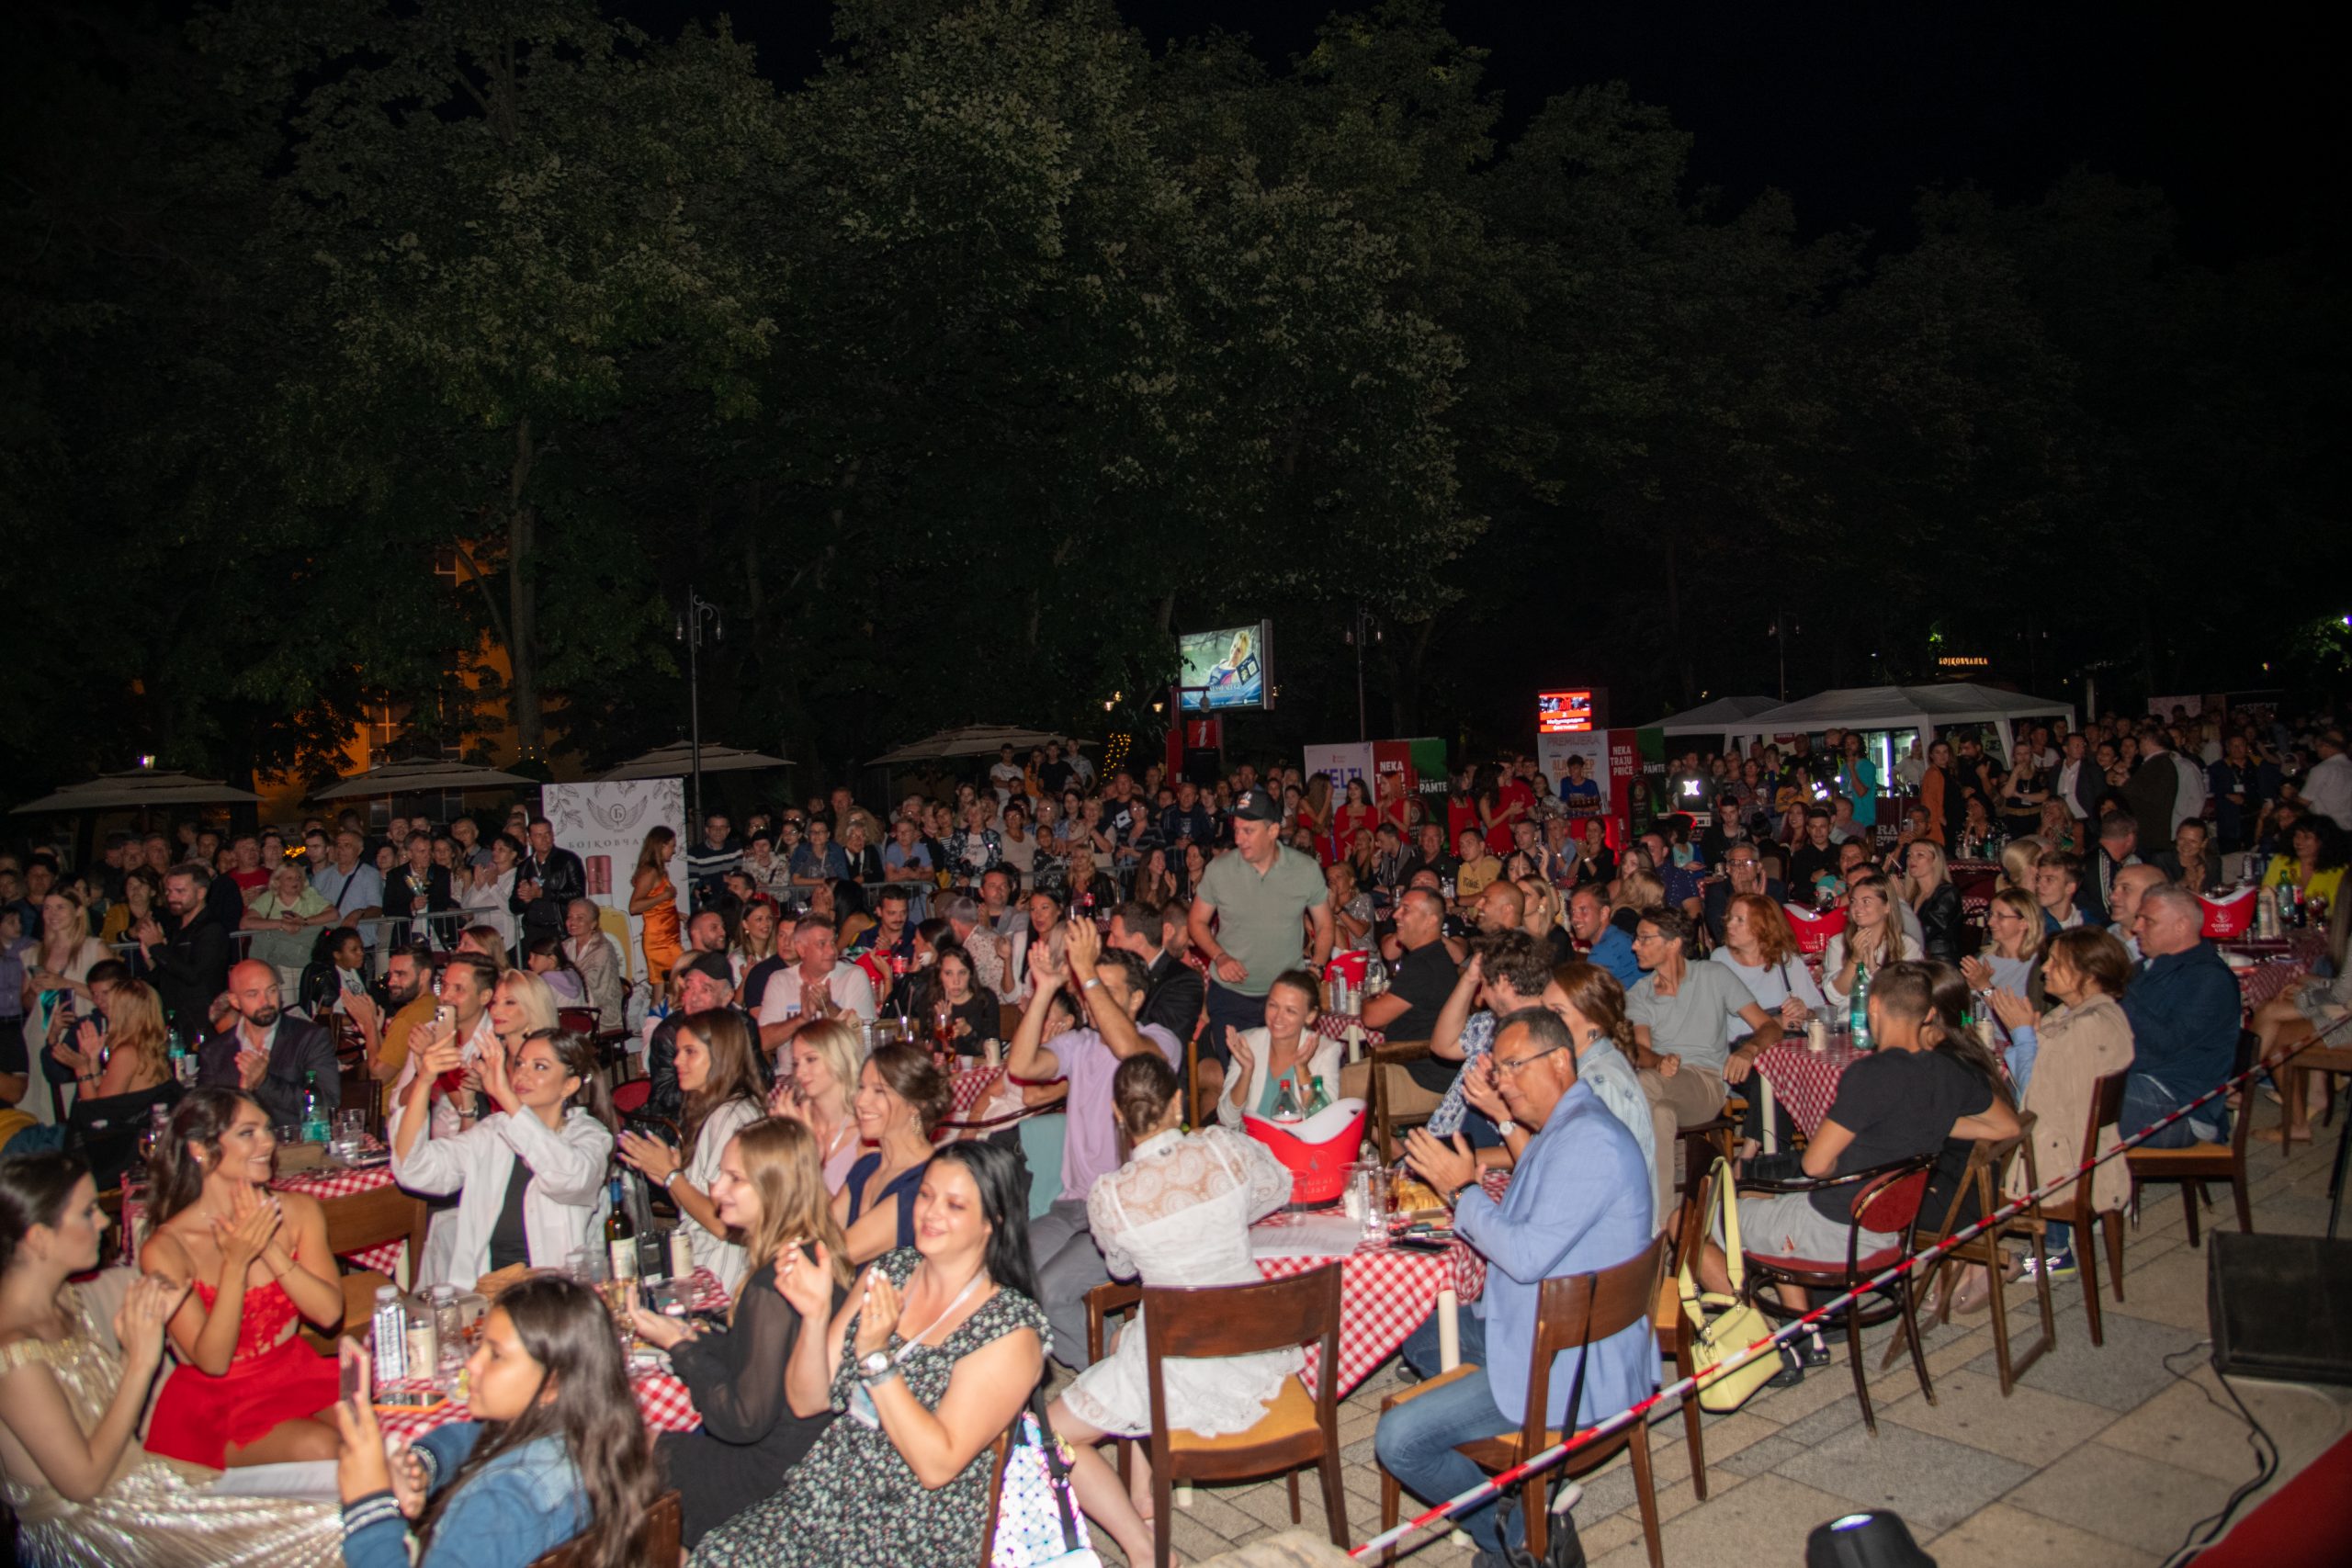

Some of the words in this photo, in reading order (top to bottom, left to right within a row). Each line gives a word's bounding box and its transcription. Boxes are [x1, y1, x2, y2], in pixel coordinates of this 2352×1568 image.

[1612, 746, 1632, 755] NEKA
[1380, 761, 1404, 772] NEKA
[1610, 756, 1633, 766] TRAJU
[1643, 763, 1665, 774] PAMTE
[1317, 768, 1363, 789] ELTI
[1419, 782, 1447, 794] PAMTE
[569, 839, 645, 849] БОЈКОВЧА
